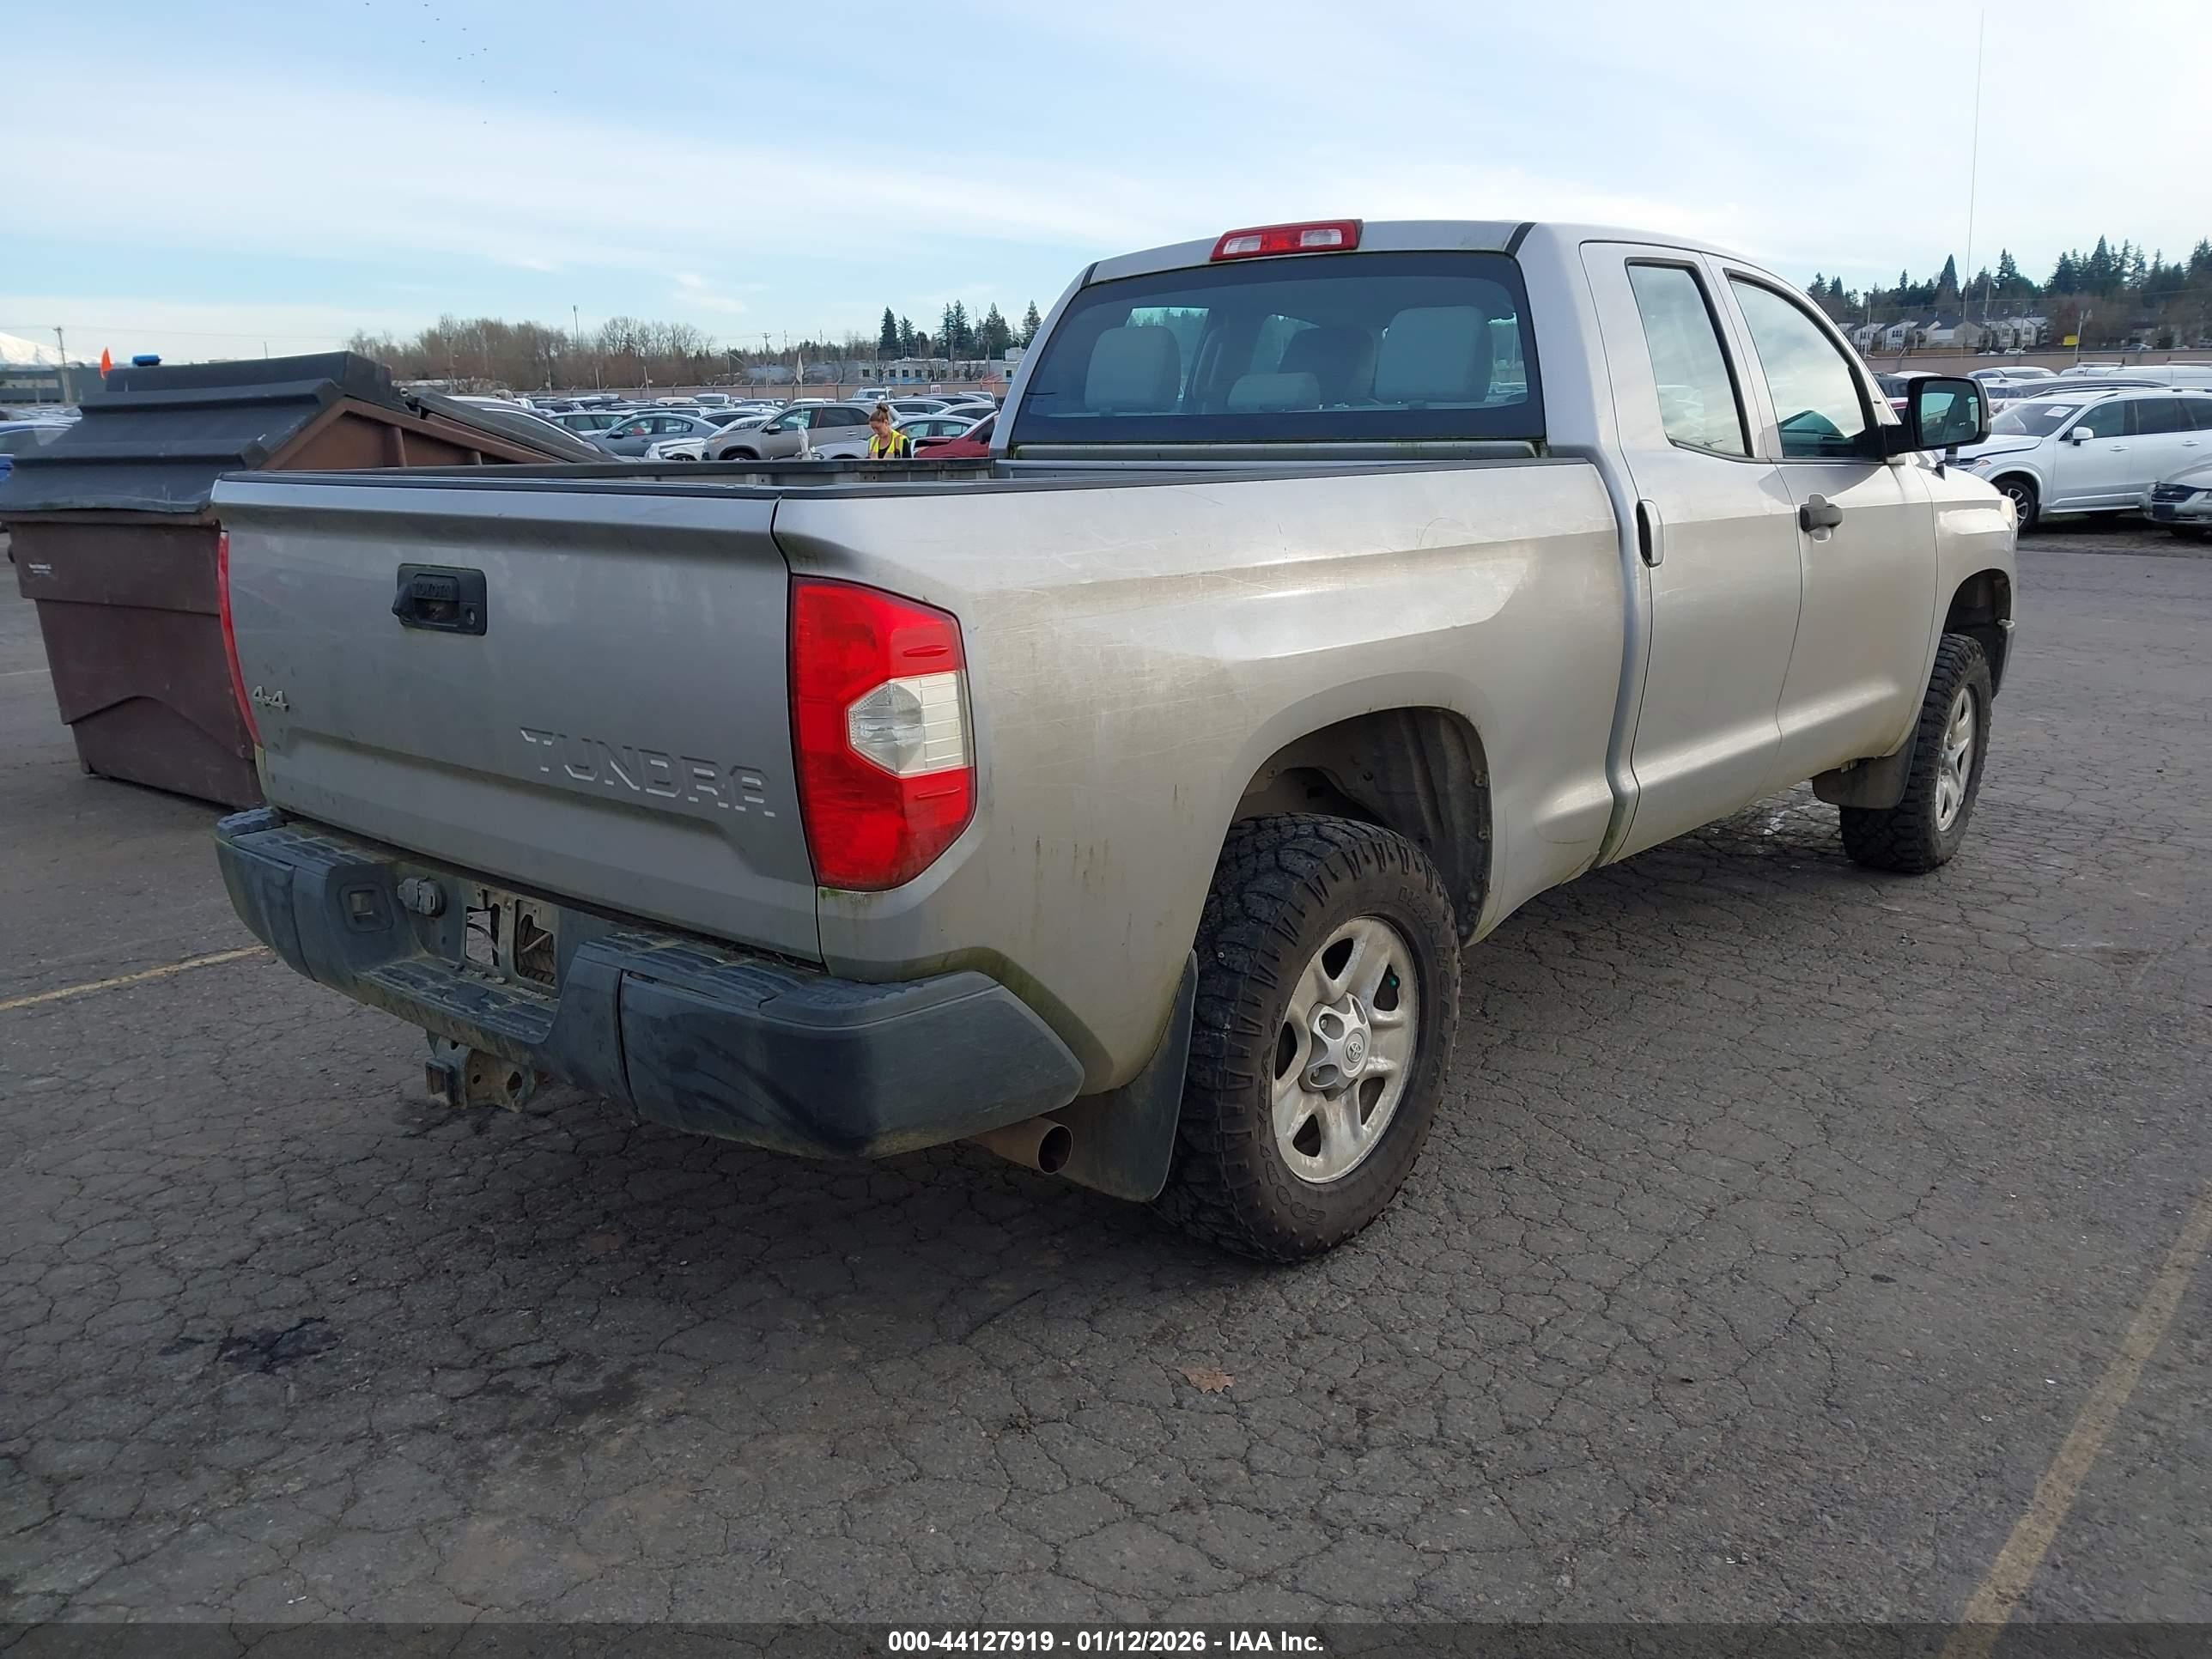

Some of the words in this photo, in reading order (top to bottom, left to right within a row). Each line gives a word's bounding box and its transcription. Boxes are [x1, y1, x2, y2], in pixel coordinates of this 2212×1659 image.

[412, 581, 454, 599] TOYOTA
[252, 685, 289, 712] 4x4
[520, 726, 776, 817] TUNDRA
